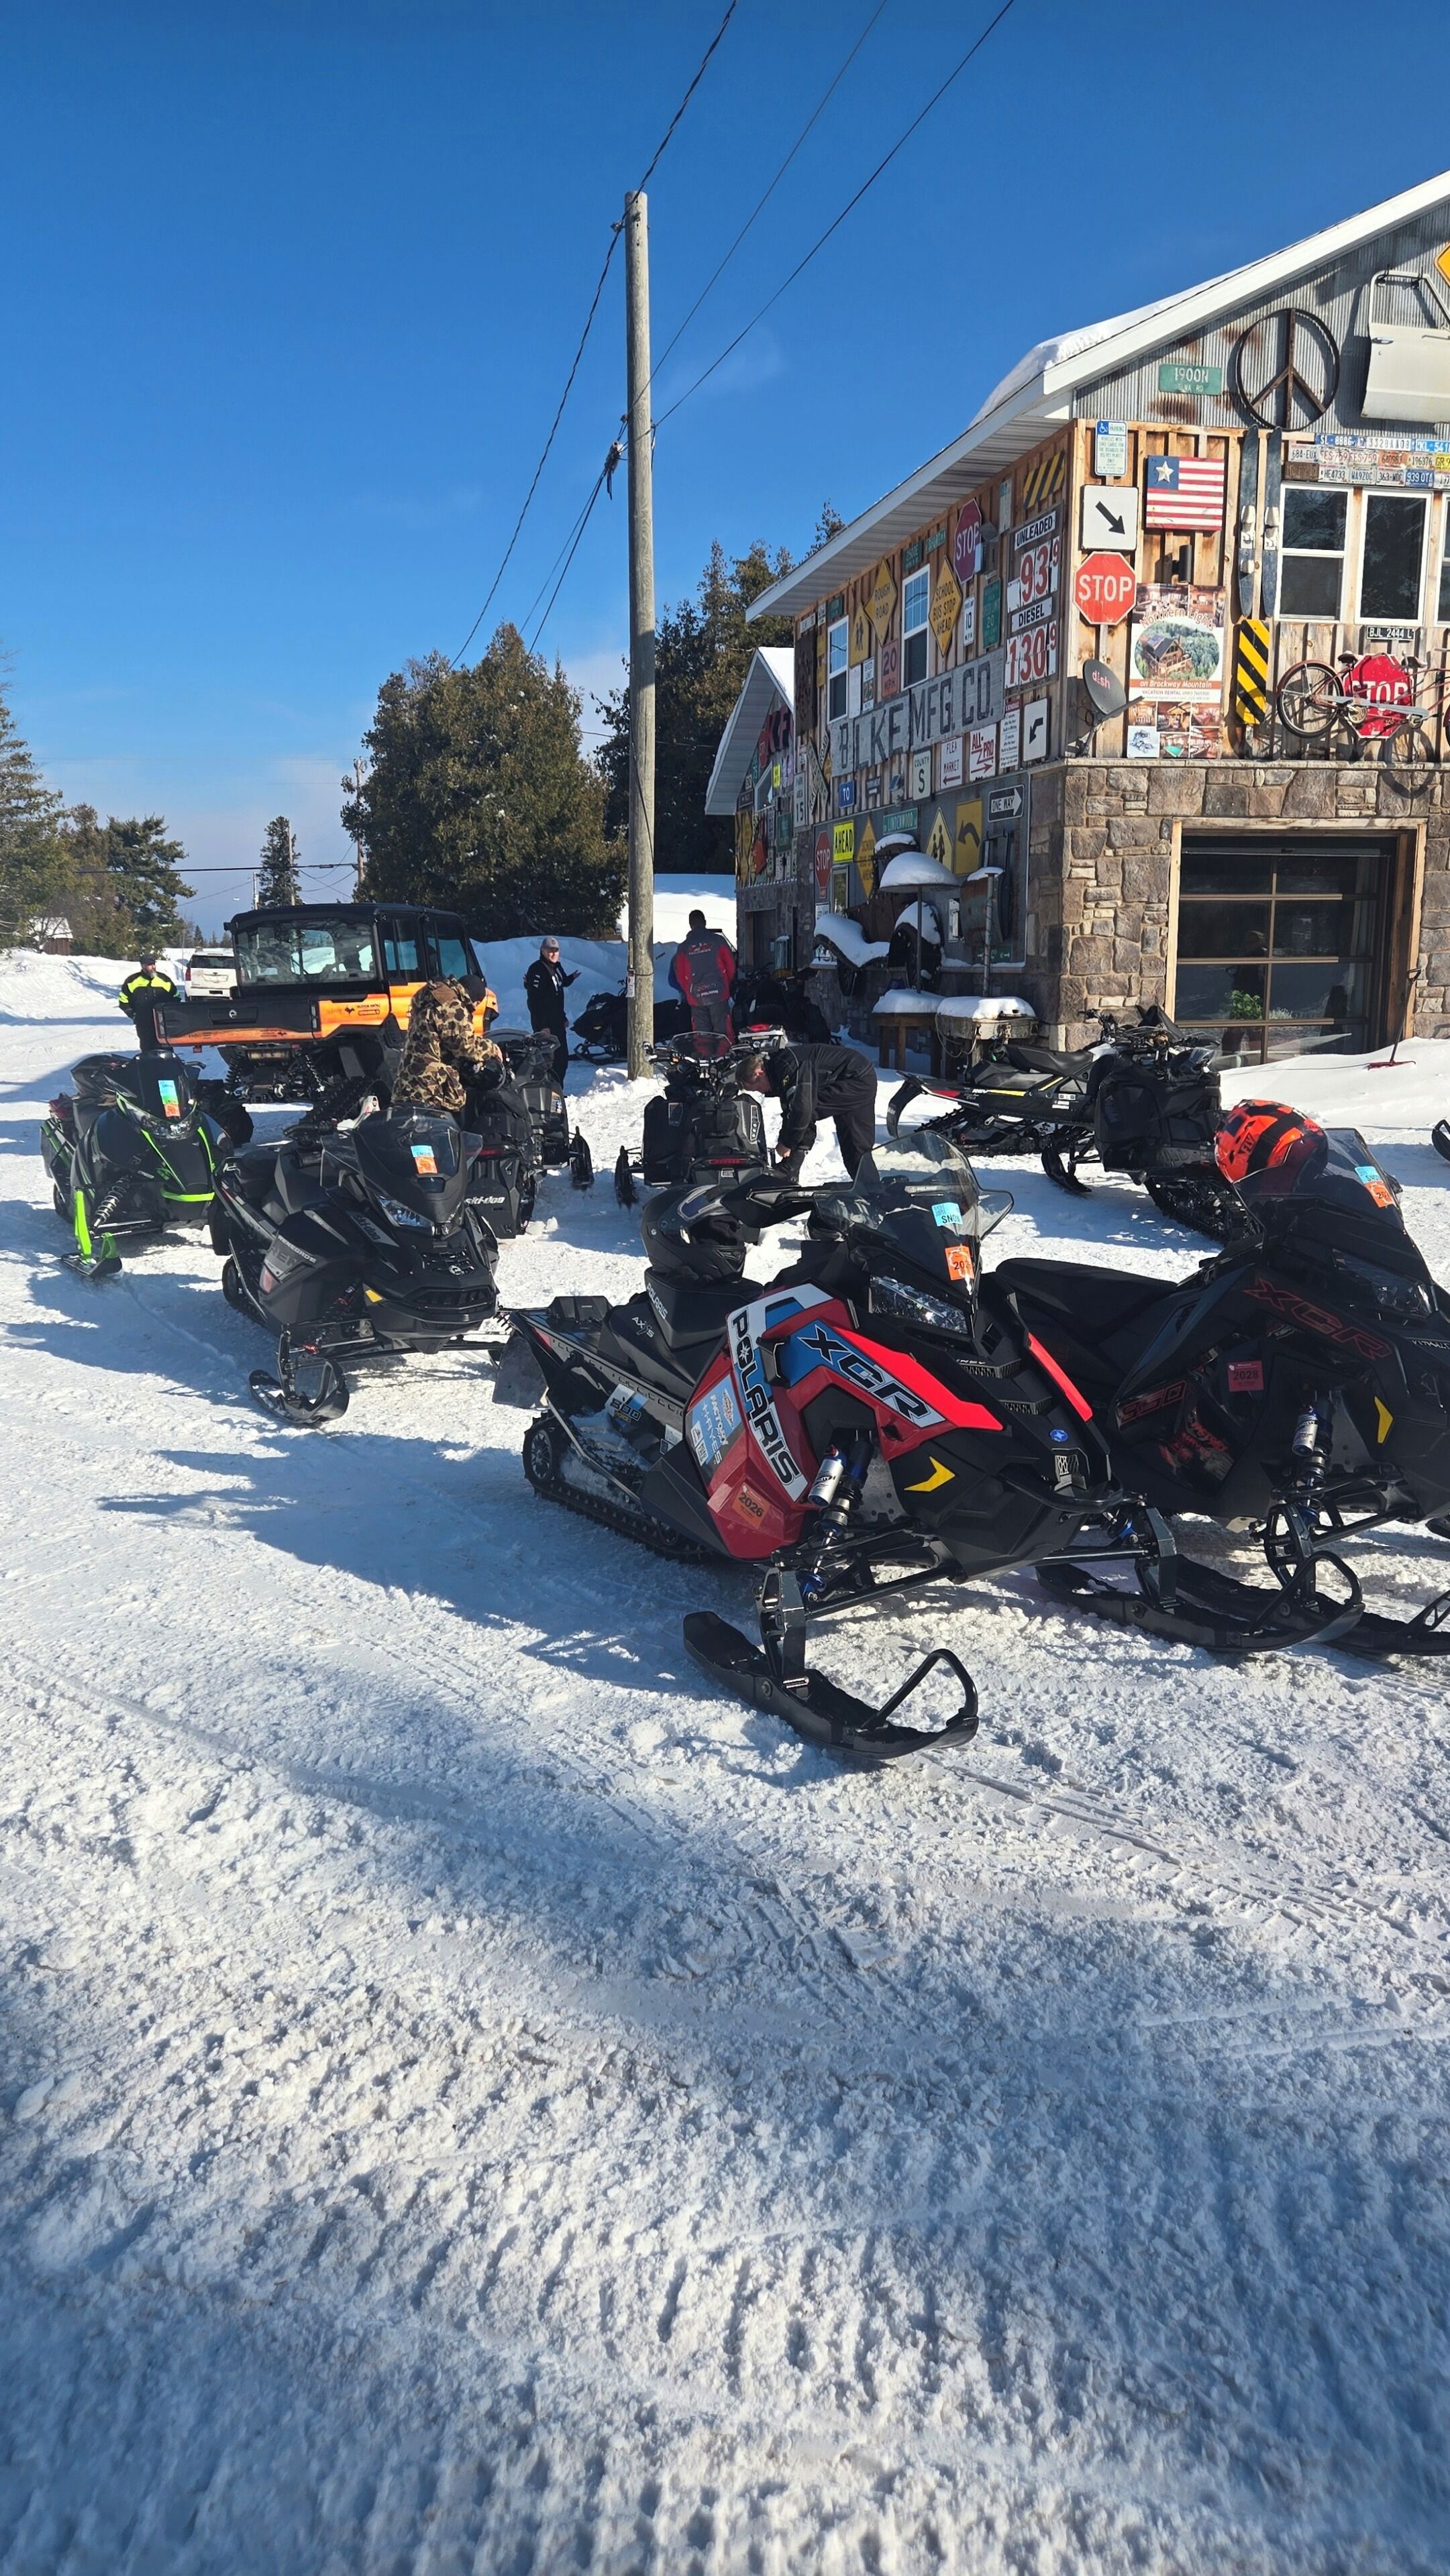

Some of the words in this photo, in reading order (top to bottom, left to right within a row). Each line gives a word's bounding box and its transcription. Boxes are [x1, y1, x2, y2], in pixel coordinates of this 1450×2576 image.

[1175, 367, 1208, 383] 1900N
[1406, 472, 1420, 482] 939
[1016, 515, 1053, 547] UNLEADED
[874, 582, 890, 602] ROUGH
[935, 581, 954, 602] SCHOOL
[1078, 574, 1133, 602] STOP
[876, 602, 889, 621] ROAD
[933, 606, 942, 622] BUS
[943, 597, 956, 616] STOP
[1019, 602, 1044, 627] DIESEL
[1139, 607, 1186, 629] Northern
[1188, 606, 1216, 631] Lights
[937, 616, 951, 635] AHEAD
[1369, 627, 1383, 637] BJL
[1386, 628, 1404, 638] 2444
[883, 645, 898, 676] 20
[1092, 670, 1110, 690] dish
[962, 661, 994, 727] CO.
[947, 741, 957, 755] FLEA
[983, 739, 994, 758] PRO
[915, 756, 929, 767] COUNTY
[944, 759, 960, 772] MARKET
[918, 768, 925, 794] S
[842, 787, 850, 801] TO
[992, 798, 1002, 812] ONE
[1003, 796, 1015, 810] WAY
[796, 801, 804, 822] 15
[835, 828, 853, 854] AHEAD
[816, 849, 831, 871] STOP
[1241, 1133, 1255, 1153] FLY
[278, 1234, 317, 1264] RENEGADE
[647, 1282, 668, 1320] POLARIS
[1243, 1277, 1392, 1360] XCR
[797, 1324, 935, 1421] XCR
[1233, 1370, 1259, 1381] 2028
[731, 1309, 800, 1487] POLARIS
[739, 1492, 764, 1517] 2026
